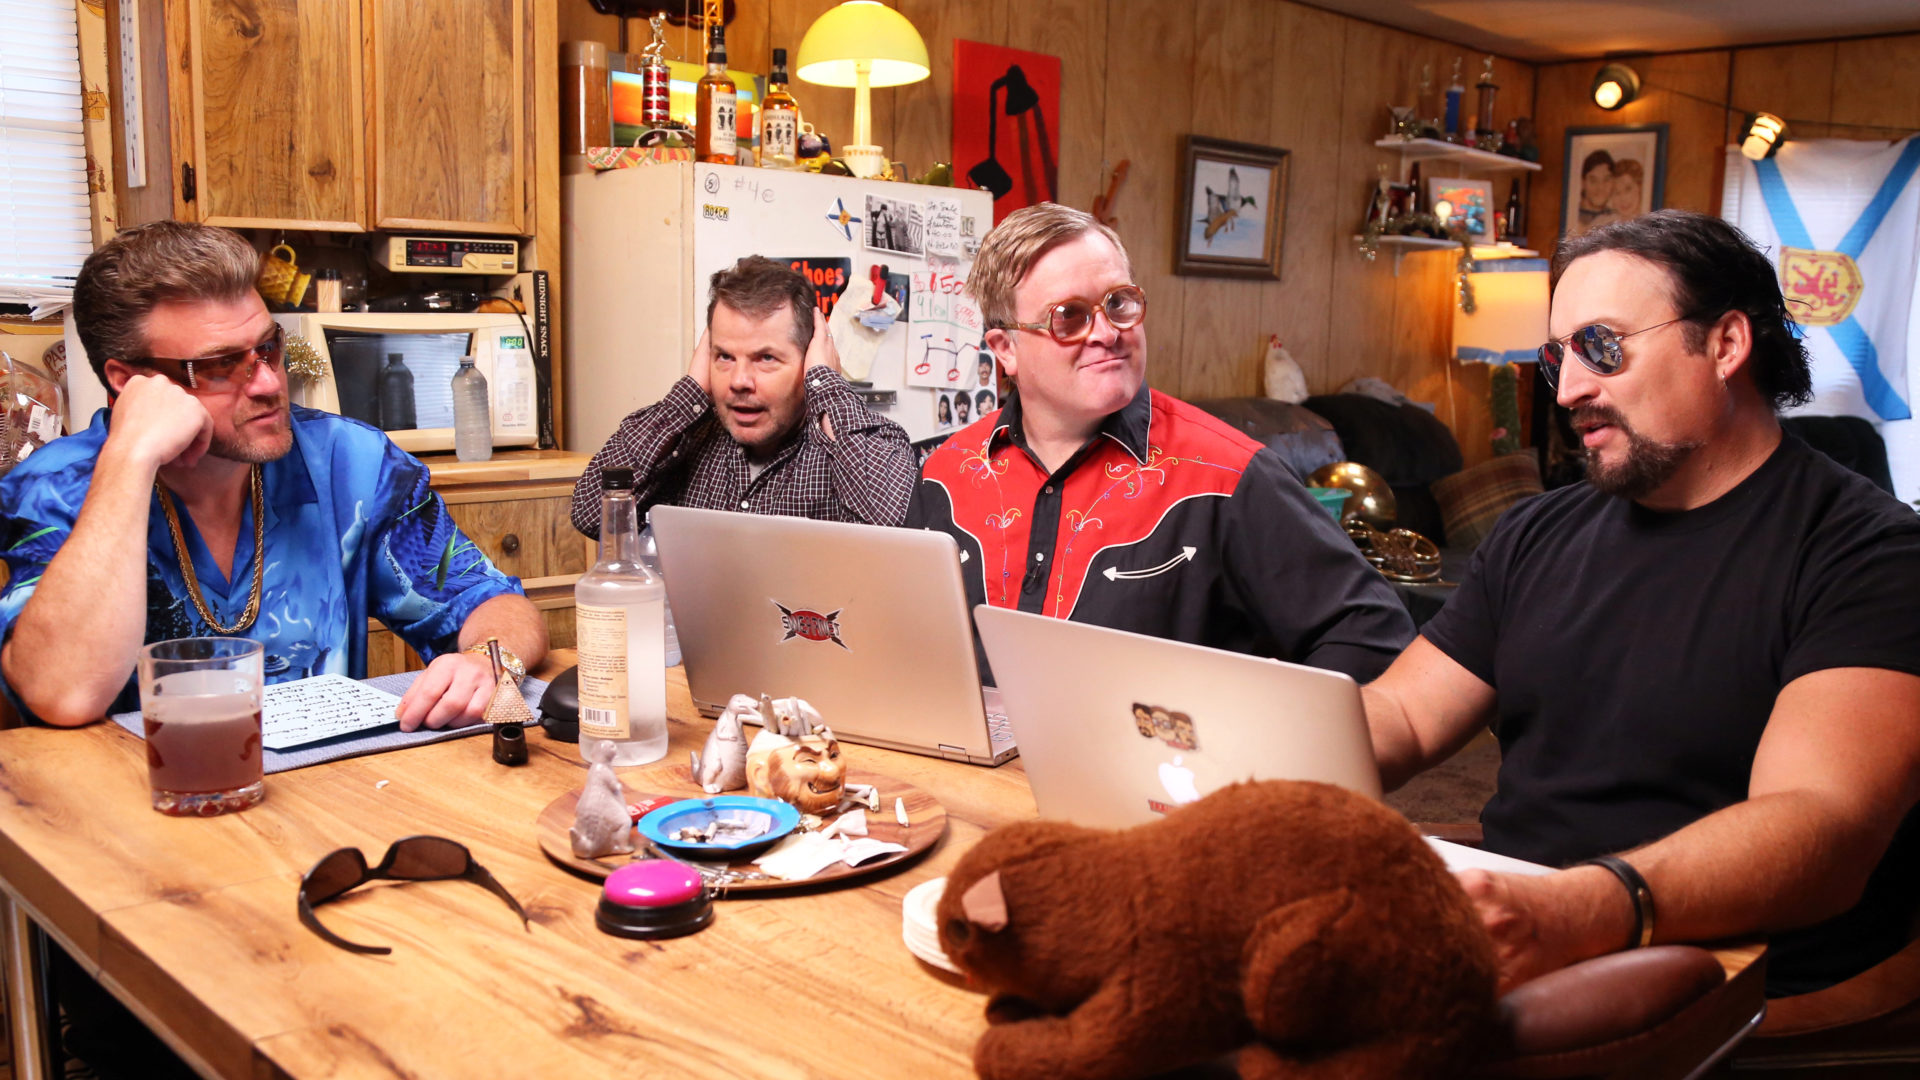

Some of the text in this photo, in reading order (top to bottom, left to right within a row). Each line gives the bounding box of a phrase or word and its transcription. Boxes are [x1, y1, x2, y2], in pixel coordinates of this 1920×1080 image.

[538, 274, 548, 357] MIDNIGHT SNACK
[782, 615, 840, 637] SWEARNET
